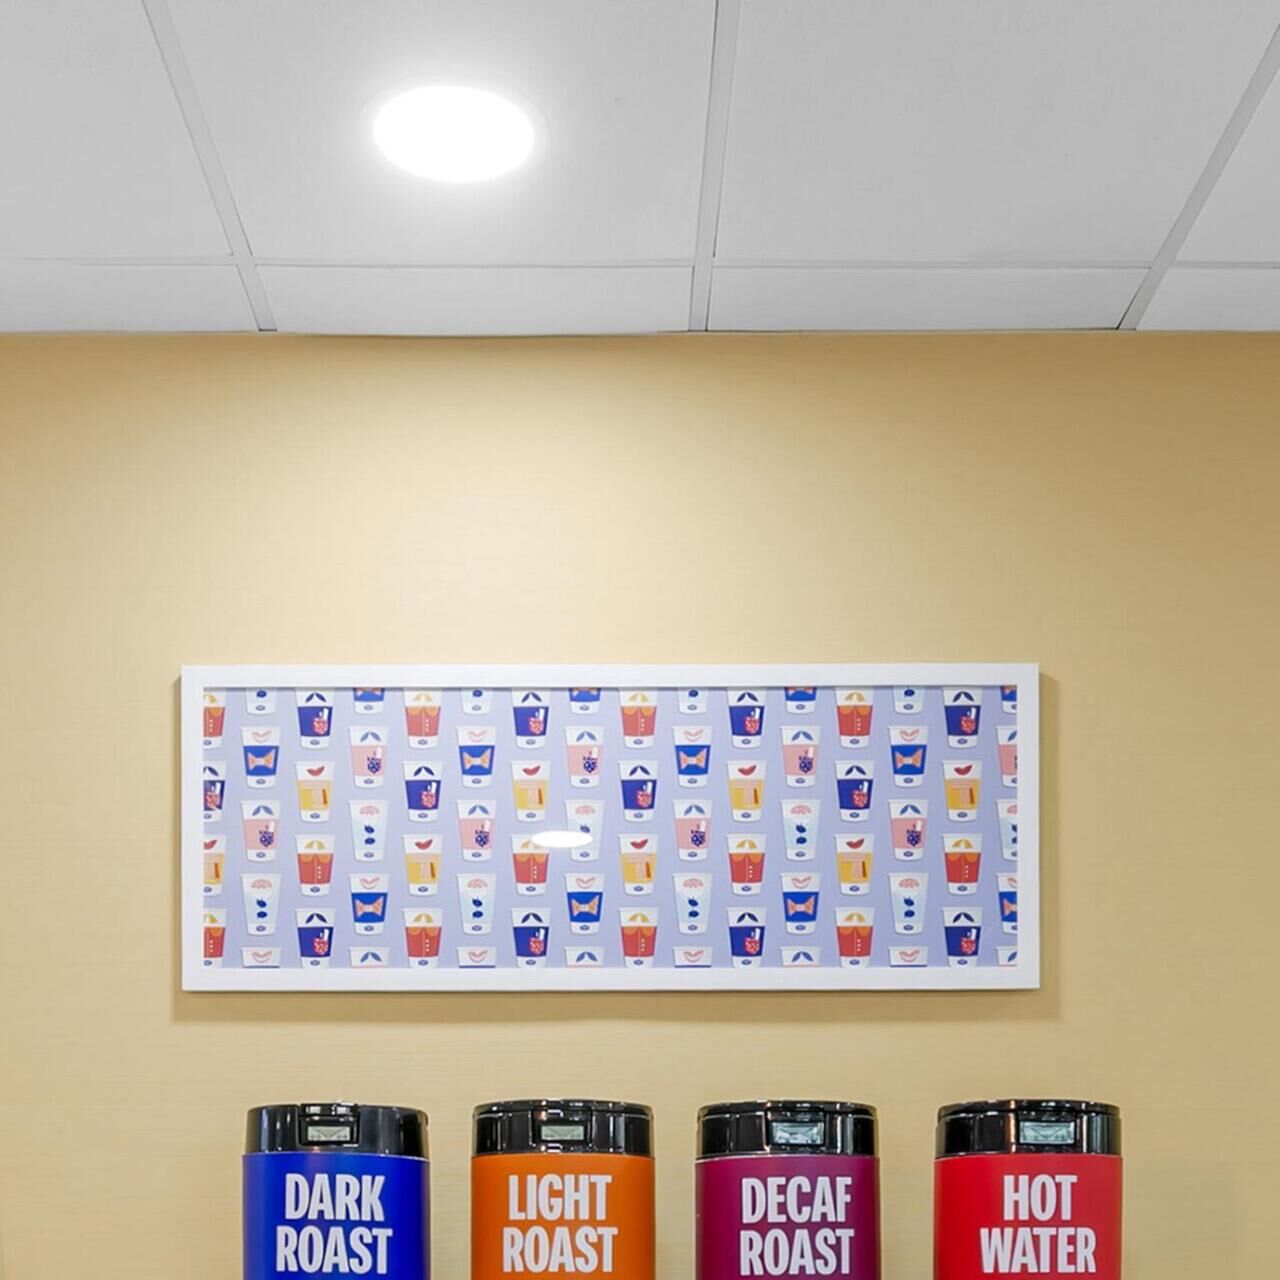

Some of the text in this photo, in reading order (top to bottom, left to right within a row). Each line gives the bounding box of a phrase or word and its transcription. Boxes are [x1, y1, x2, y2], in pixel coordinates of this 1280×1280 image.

[285, 1173, 386, 1221] DARK
[508, 1174, 612, 1220] LIGHT
[742, 1175, 853, 1224] DECAF
[1003, 1174, 1078, 1221] HOT
[275, 1226, 393, 1274] ROAST
[503, 1226, 619, 1273] ROAST
[739, 1228, 855, 1276] ROAST
[980, 1227, 1097, 1274] WATER
